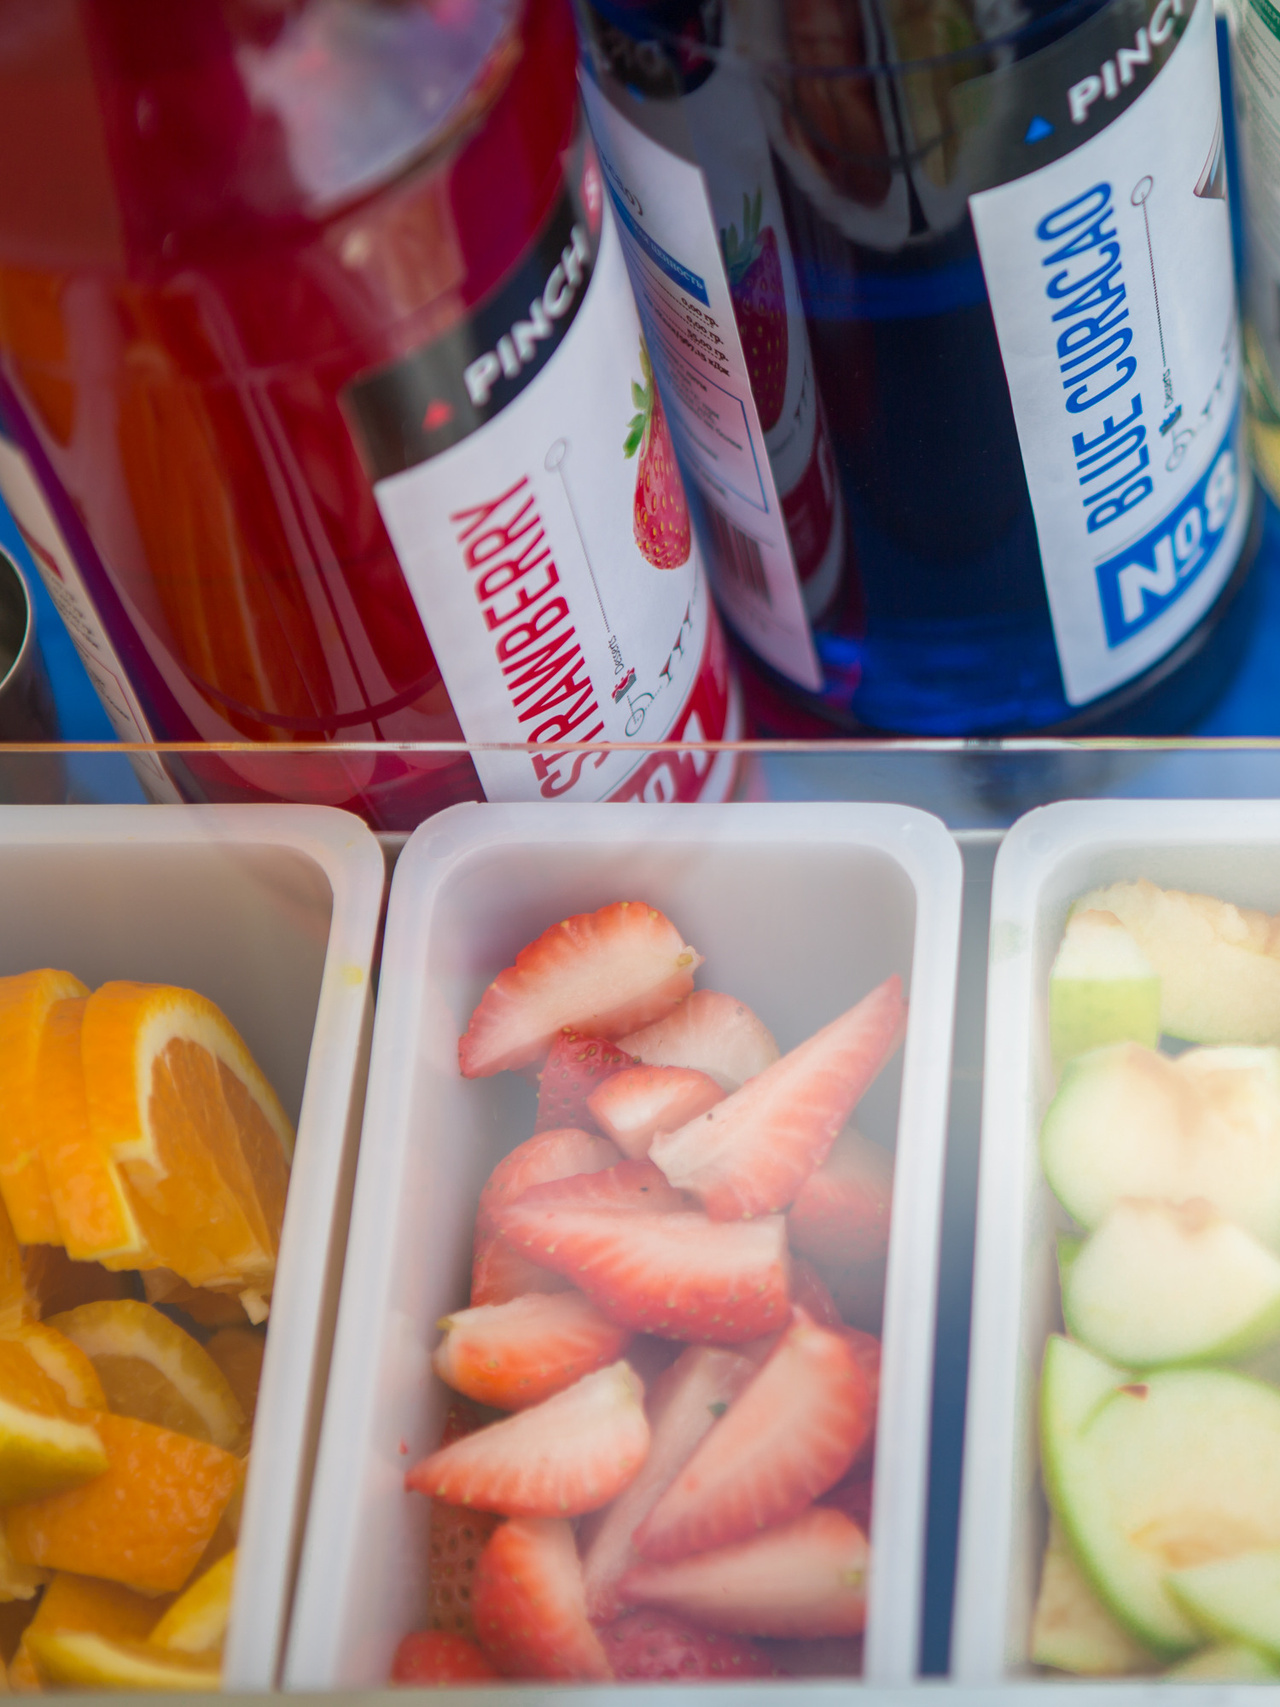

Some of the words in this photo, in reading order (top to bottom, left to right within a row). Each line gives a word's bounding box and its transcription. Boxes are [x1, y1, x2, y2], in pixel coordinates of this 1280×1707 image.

[1068, 0, 1183, 124] PINC
[463, 223, 590, 405] PINCH
[681, 297, 704, 317] 0,00
[686, 315, 708, 334] 0,00
[1035, 180, 1138, 414] CURACAO
[1071, 392, 1154, 535] BLUE
[449, 472, 613, 799] STRAWBERRY
[608, 634, 625, 675] Desserts
